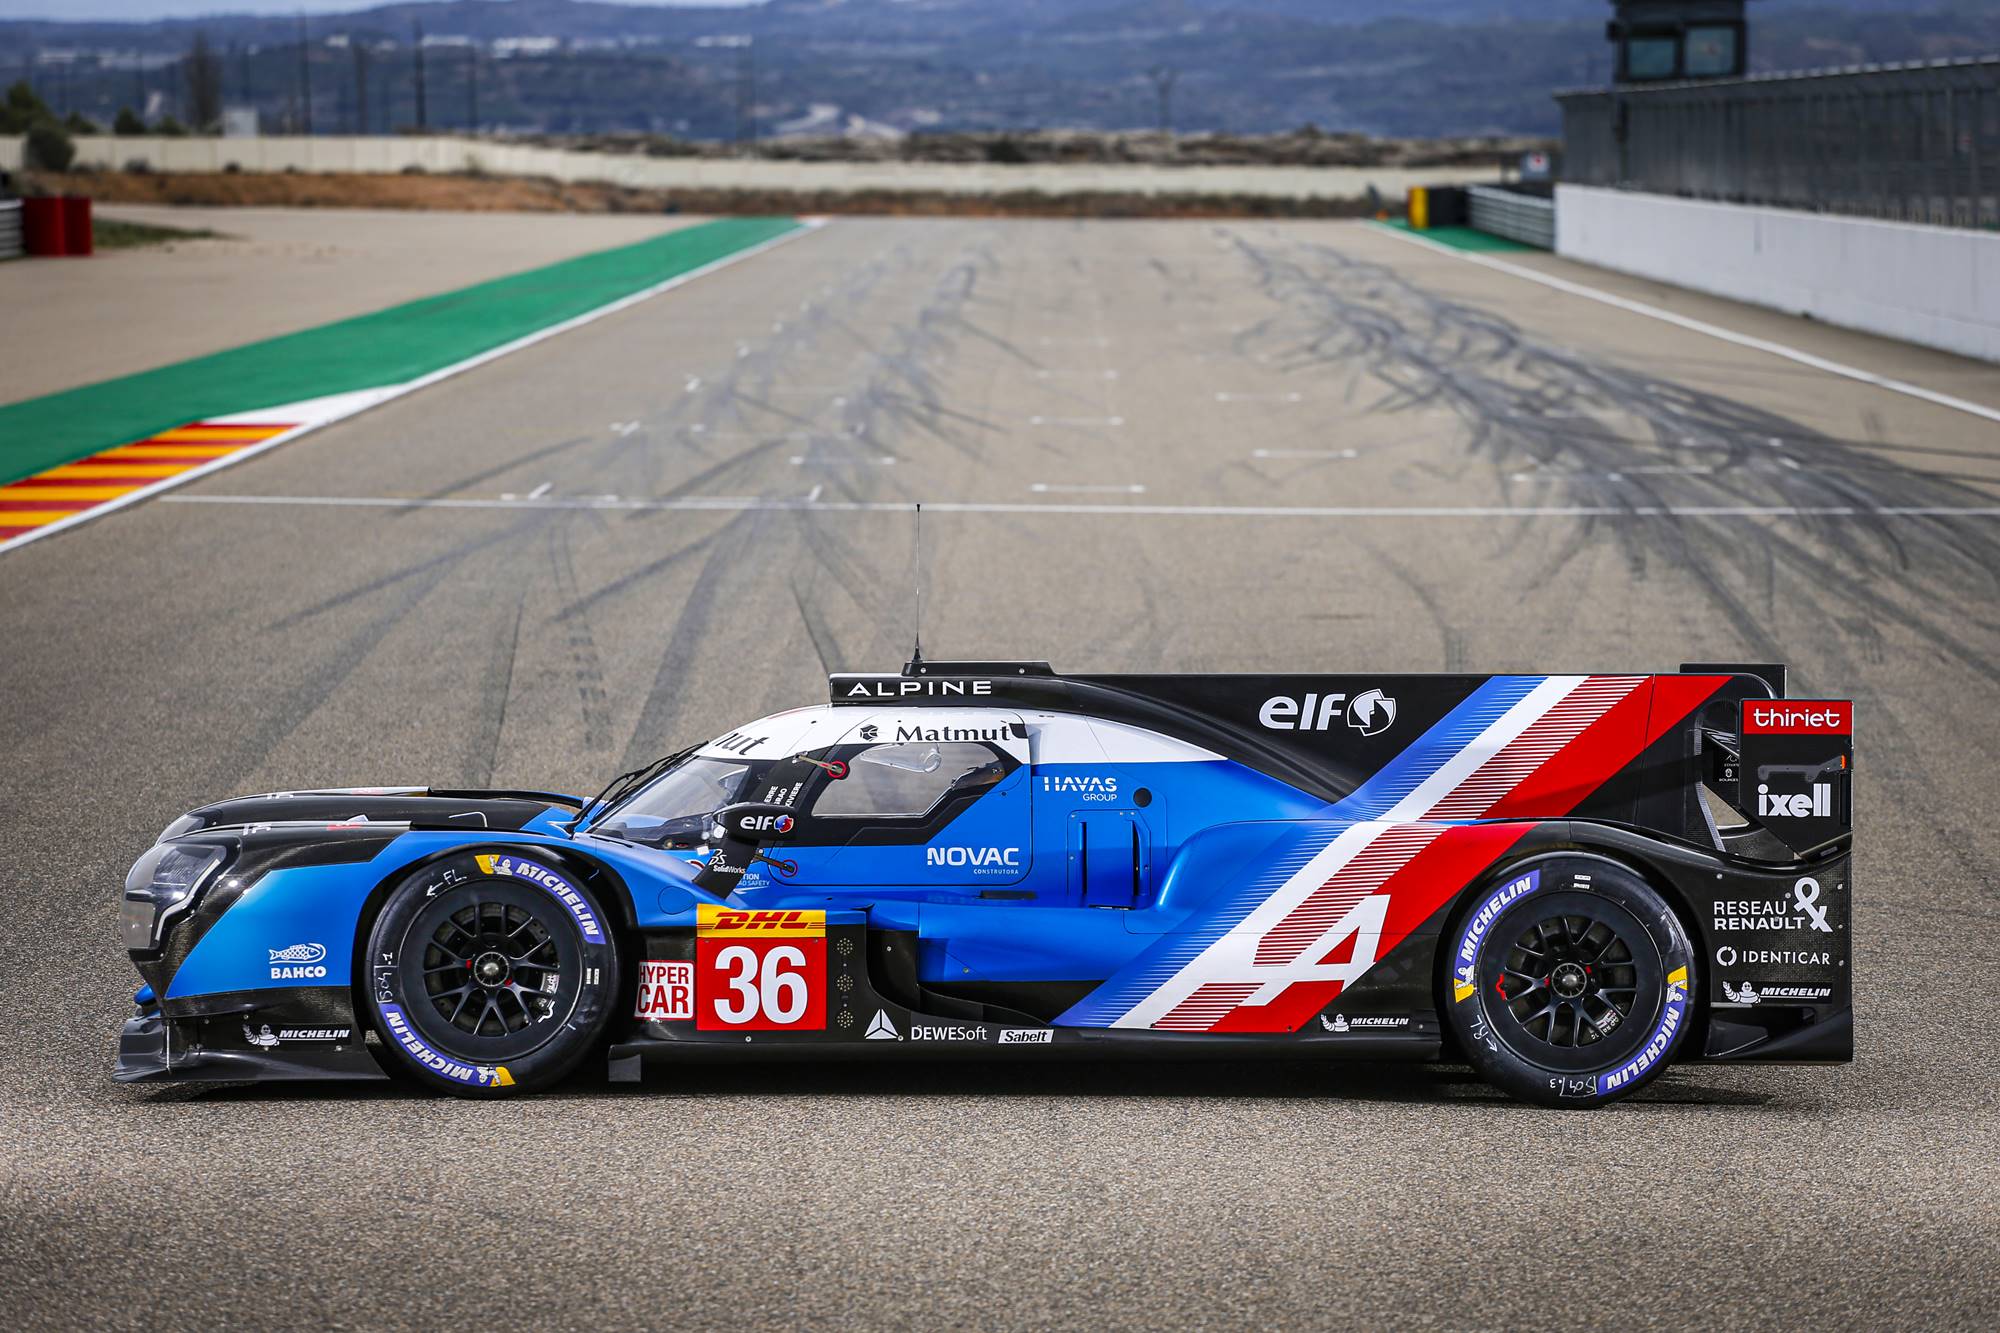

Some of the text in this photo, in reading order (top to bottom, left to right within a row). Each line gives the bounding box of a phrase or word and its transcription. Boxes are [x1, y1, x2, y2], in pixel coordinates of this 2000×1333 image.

[847, 680, 992, 697] ALPINE
[1258, 693, 1346, 731] elf
[1753, 708, 1840, 727] thiriet
[895, 725, 1010, 742] Matmut
[1044, 776, 1117, 792] HAVAS
[1083, 793, 1117, 802] GROUP
[1757, 783, 1831, 818] ixell
[740, 815, 775, 831] elf
[927, 847, 1019, 866] NOVAC
[515, 862, 600, 935] MICHELIN
[1713, 900, 1787, 915] RESEAU
[713, 911, 808, 930] DHL
[1460, 876, 1531, 963] MICHELIN
[1714, 916, 1806, 931] RENAULT
[1742, 950, 1831, 965] IDENTICAR
[270, 965, 327, 980] BAHCO
[639, 965, 689, 985] HYPER
[713, 945, 808, 1024] 36
[1760, 986, 1832, 997] MICHELIN
[637, 984, 689, 1015] CAR
[1350, 1017, 1410, 1026] MICHELIN
[279, 1029, 351, 1038] MICHELIN
[910, 1025, 988, 1041] DEWESoft
[1004, 1030, 1048, 1043] Sabelt
[385, 1011, 474, 1081] MICHELIN
[1606, 1006, 1680, 1090] MICHELIN
